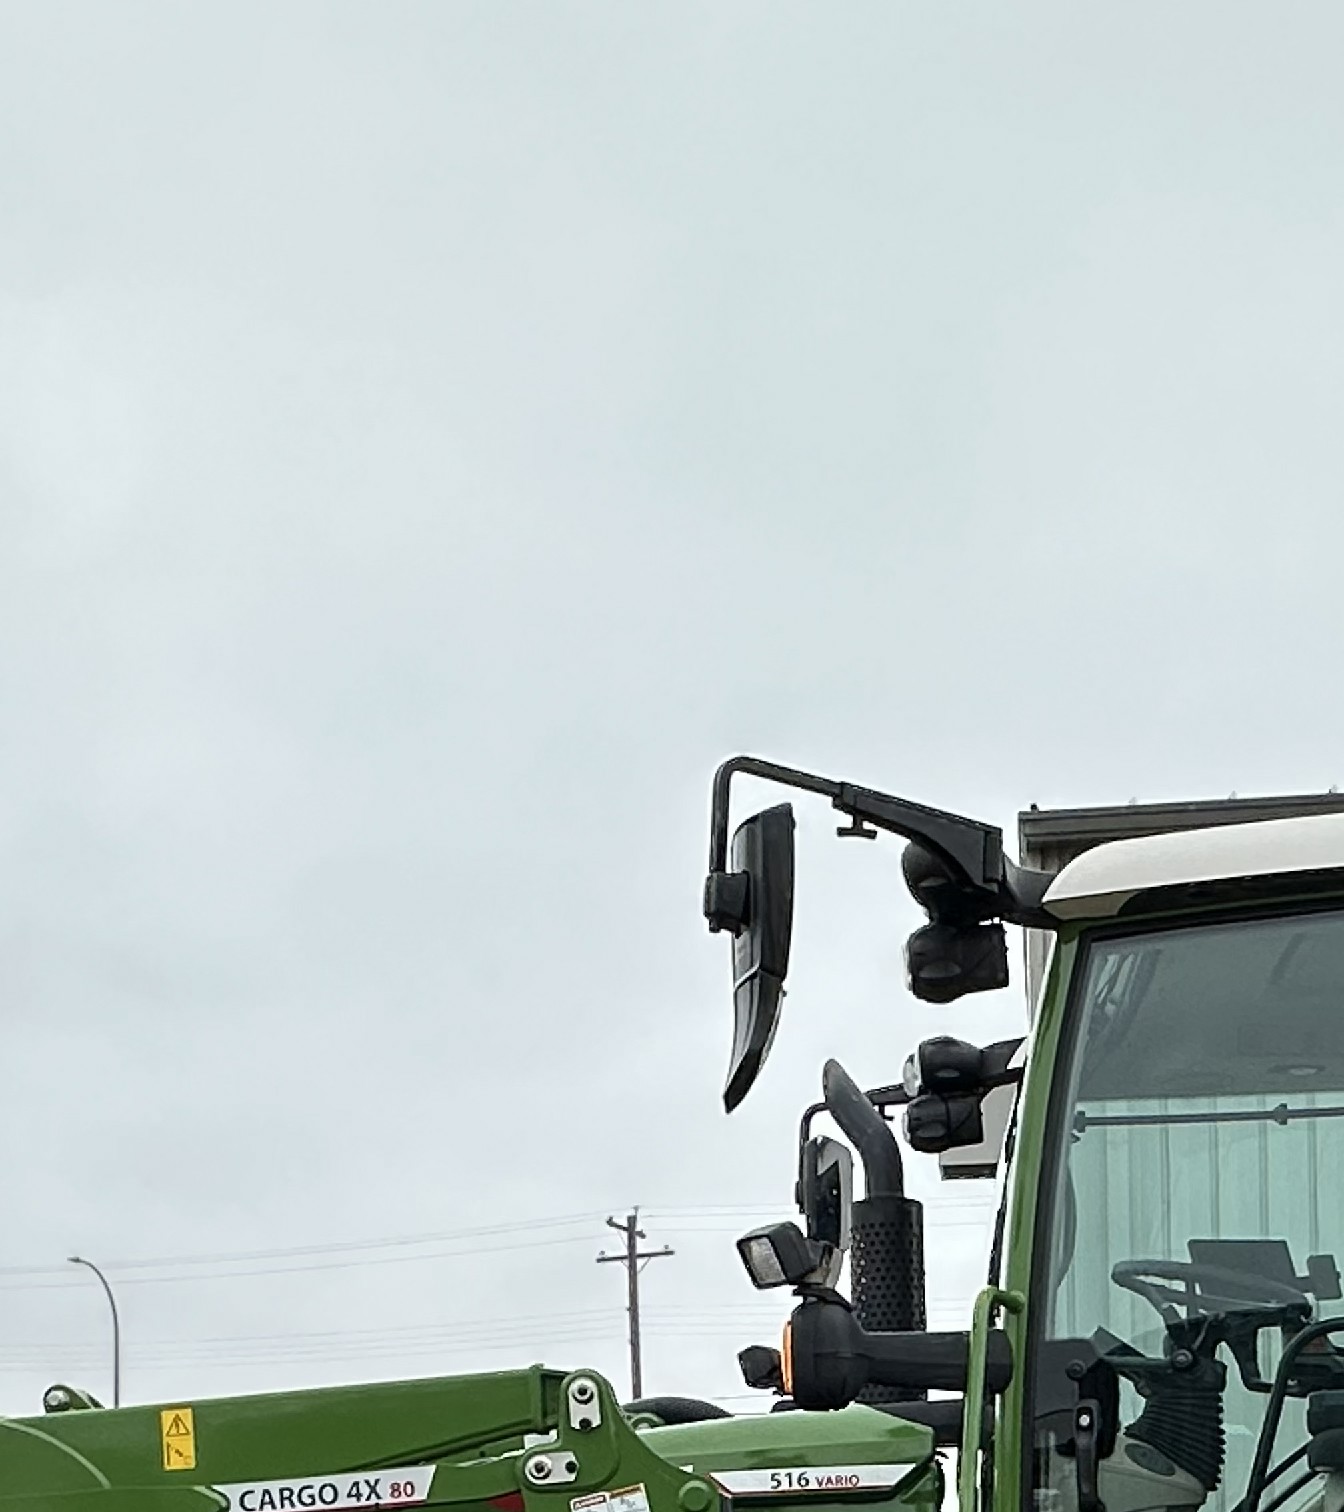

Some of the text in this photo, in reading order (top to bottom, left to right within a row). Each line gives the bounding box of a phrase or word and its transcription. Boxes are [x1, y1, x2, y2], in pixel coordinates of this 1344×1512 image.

[770, 1472, 860, 1489] 516 VARIO
[239, 1478, 416, 1512] CARGO 4X 80
